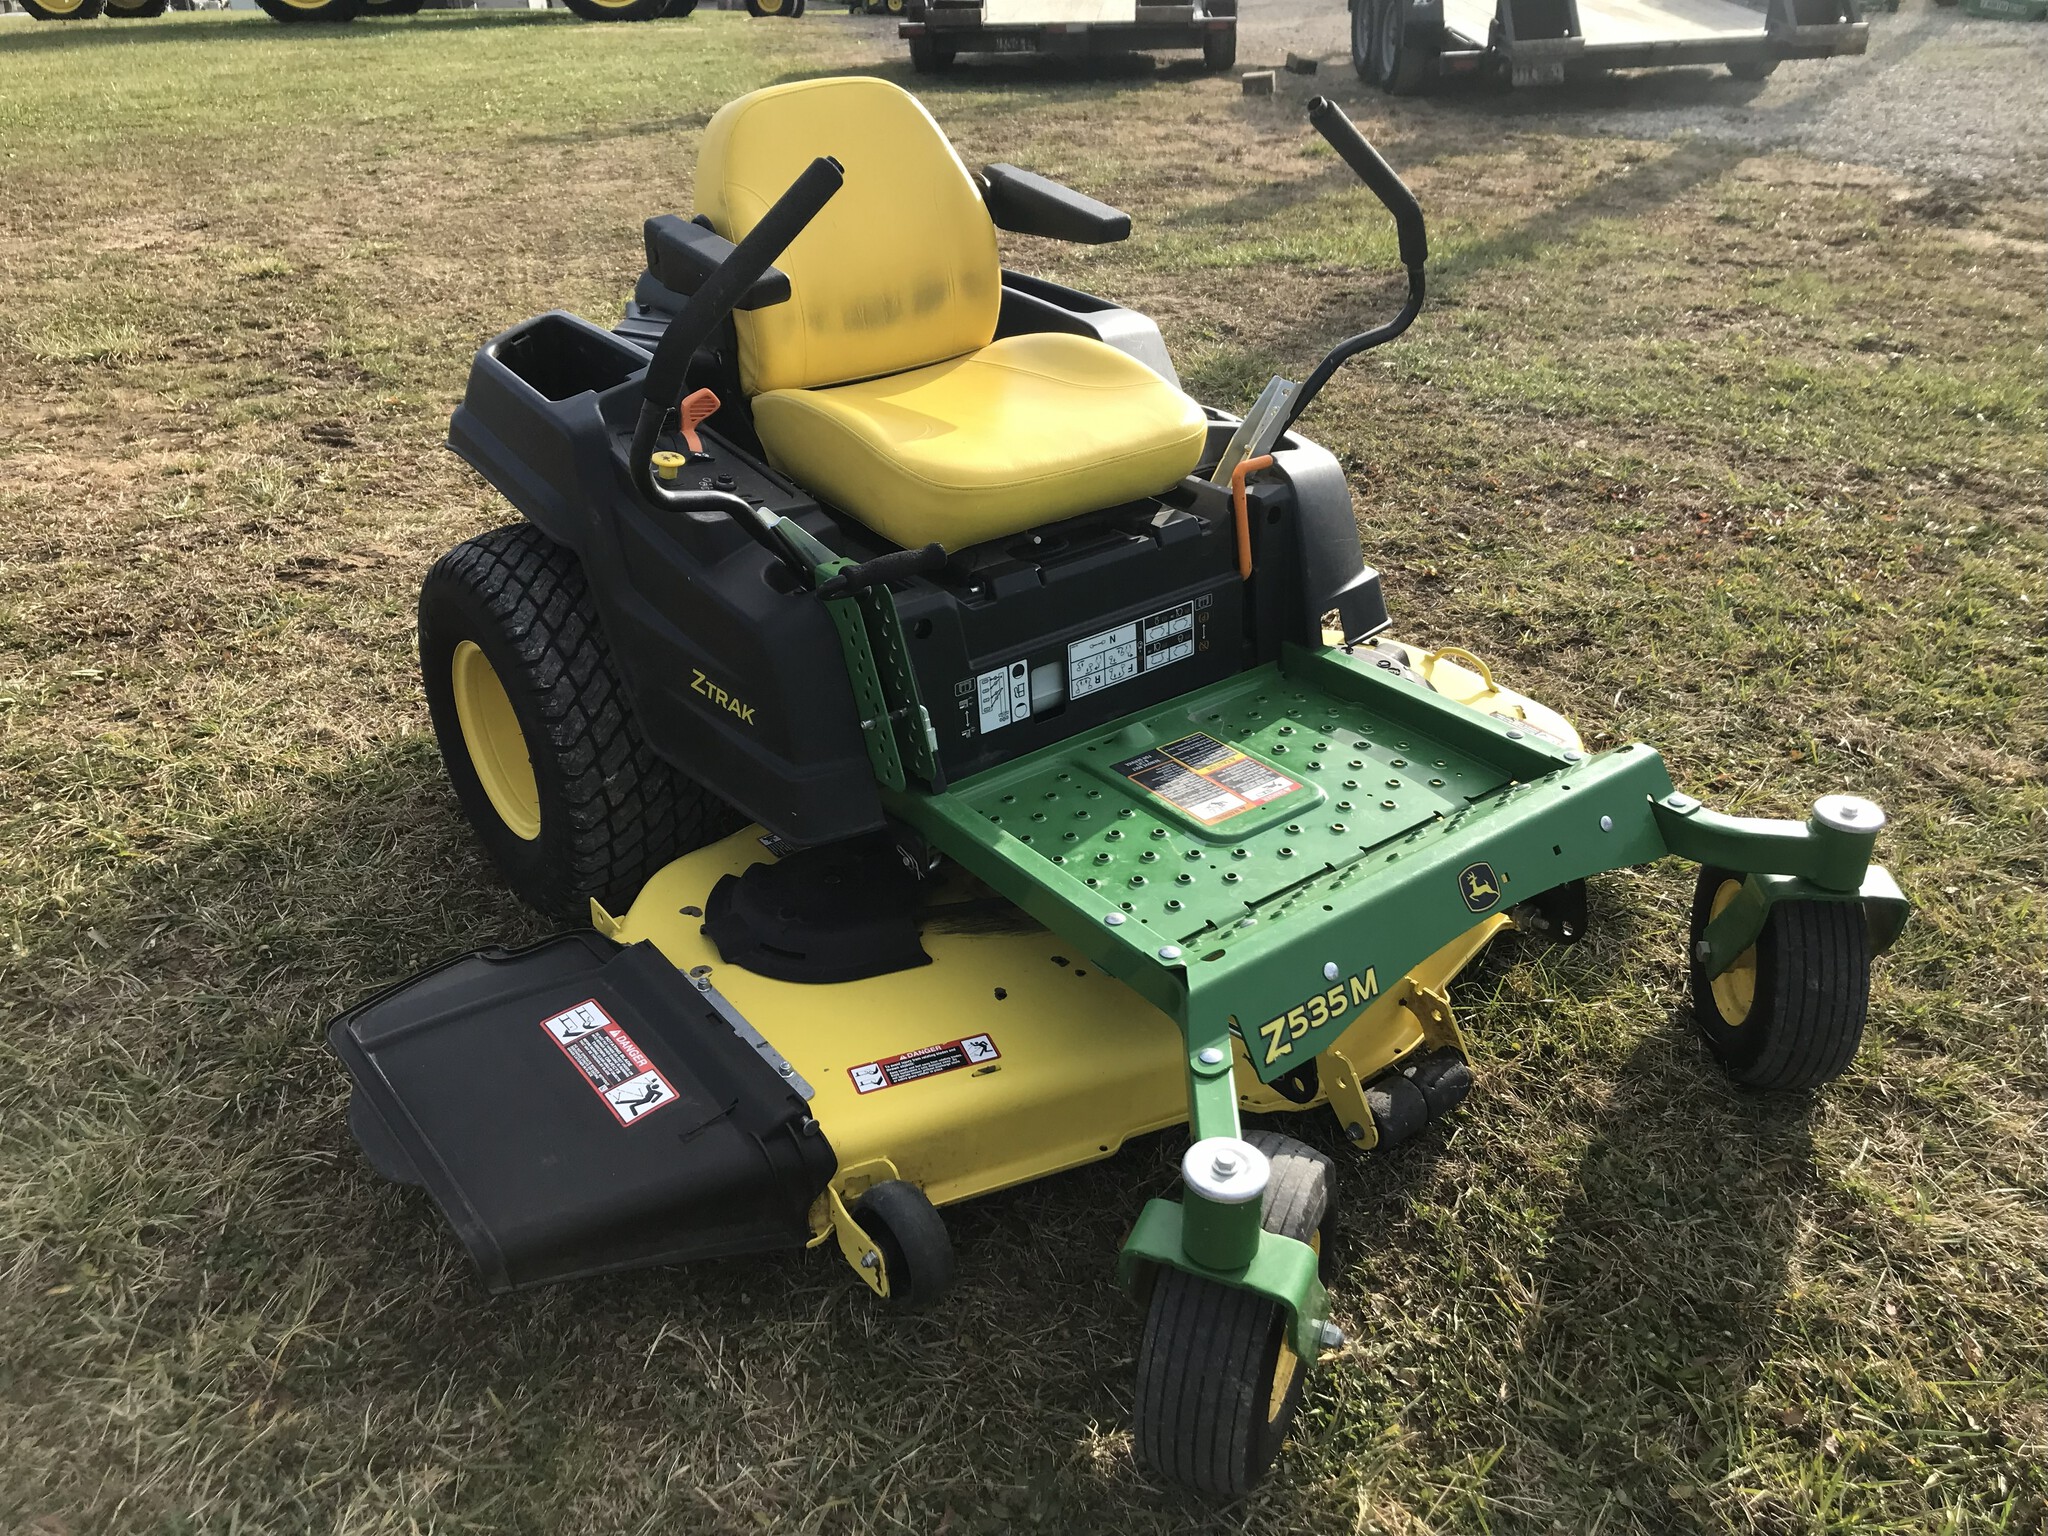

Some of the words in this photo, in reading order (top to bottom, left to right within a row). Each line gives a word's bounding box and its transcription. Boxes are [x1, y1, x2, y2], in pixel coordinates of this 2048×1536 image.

[1109, 634, 1116, 644] N
[1127, 664, 1134, 673] F
[690, 668, 755, 726] ZTRAK
[614, 1034, 649, 1067] DANGER
[905, 1044, 942, 1058] DANGER
